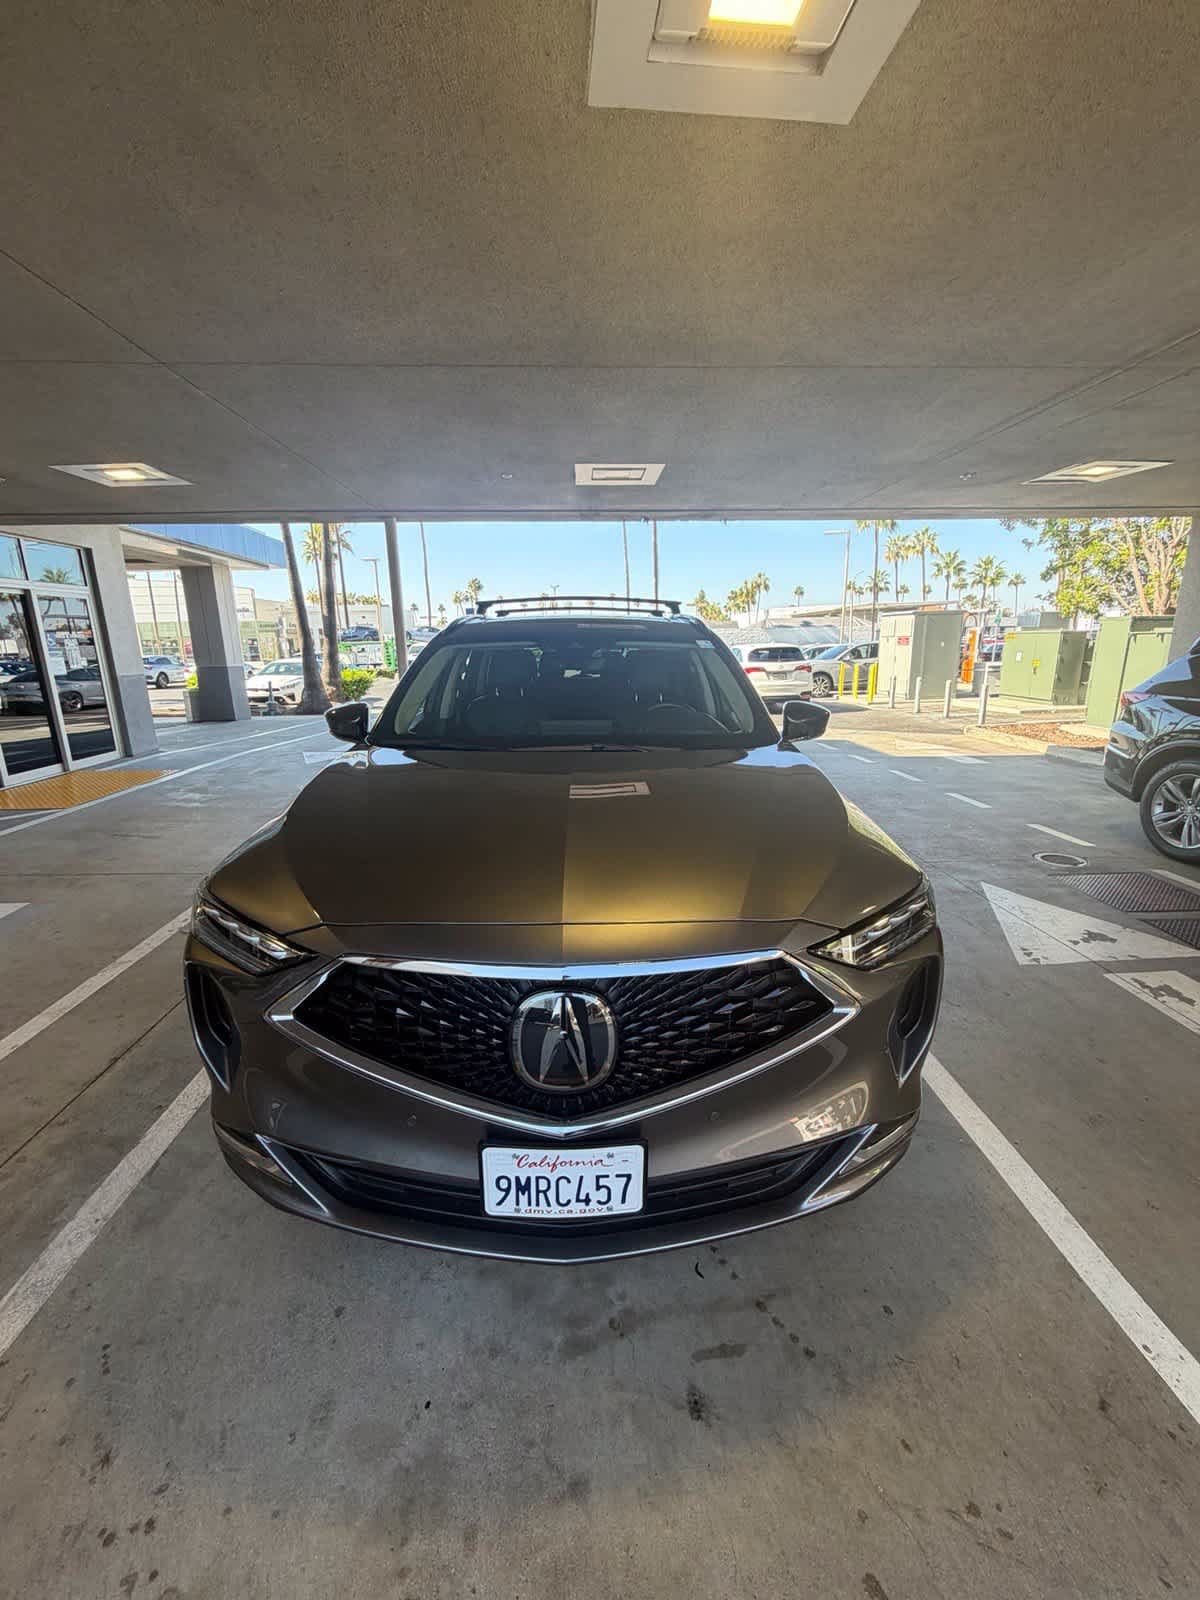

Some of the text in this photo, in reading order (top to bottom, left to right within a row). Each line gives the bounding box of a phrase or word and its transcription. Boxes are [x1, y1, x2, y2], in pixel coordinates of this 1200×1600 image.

[516, 1154, 614, 1173] California
[495, 1173, 632, 1207] 9MRC457
[524, 1206, 604, 1215] dmv.ca.gov
